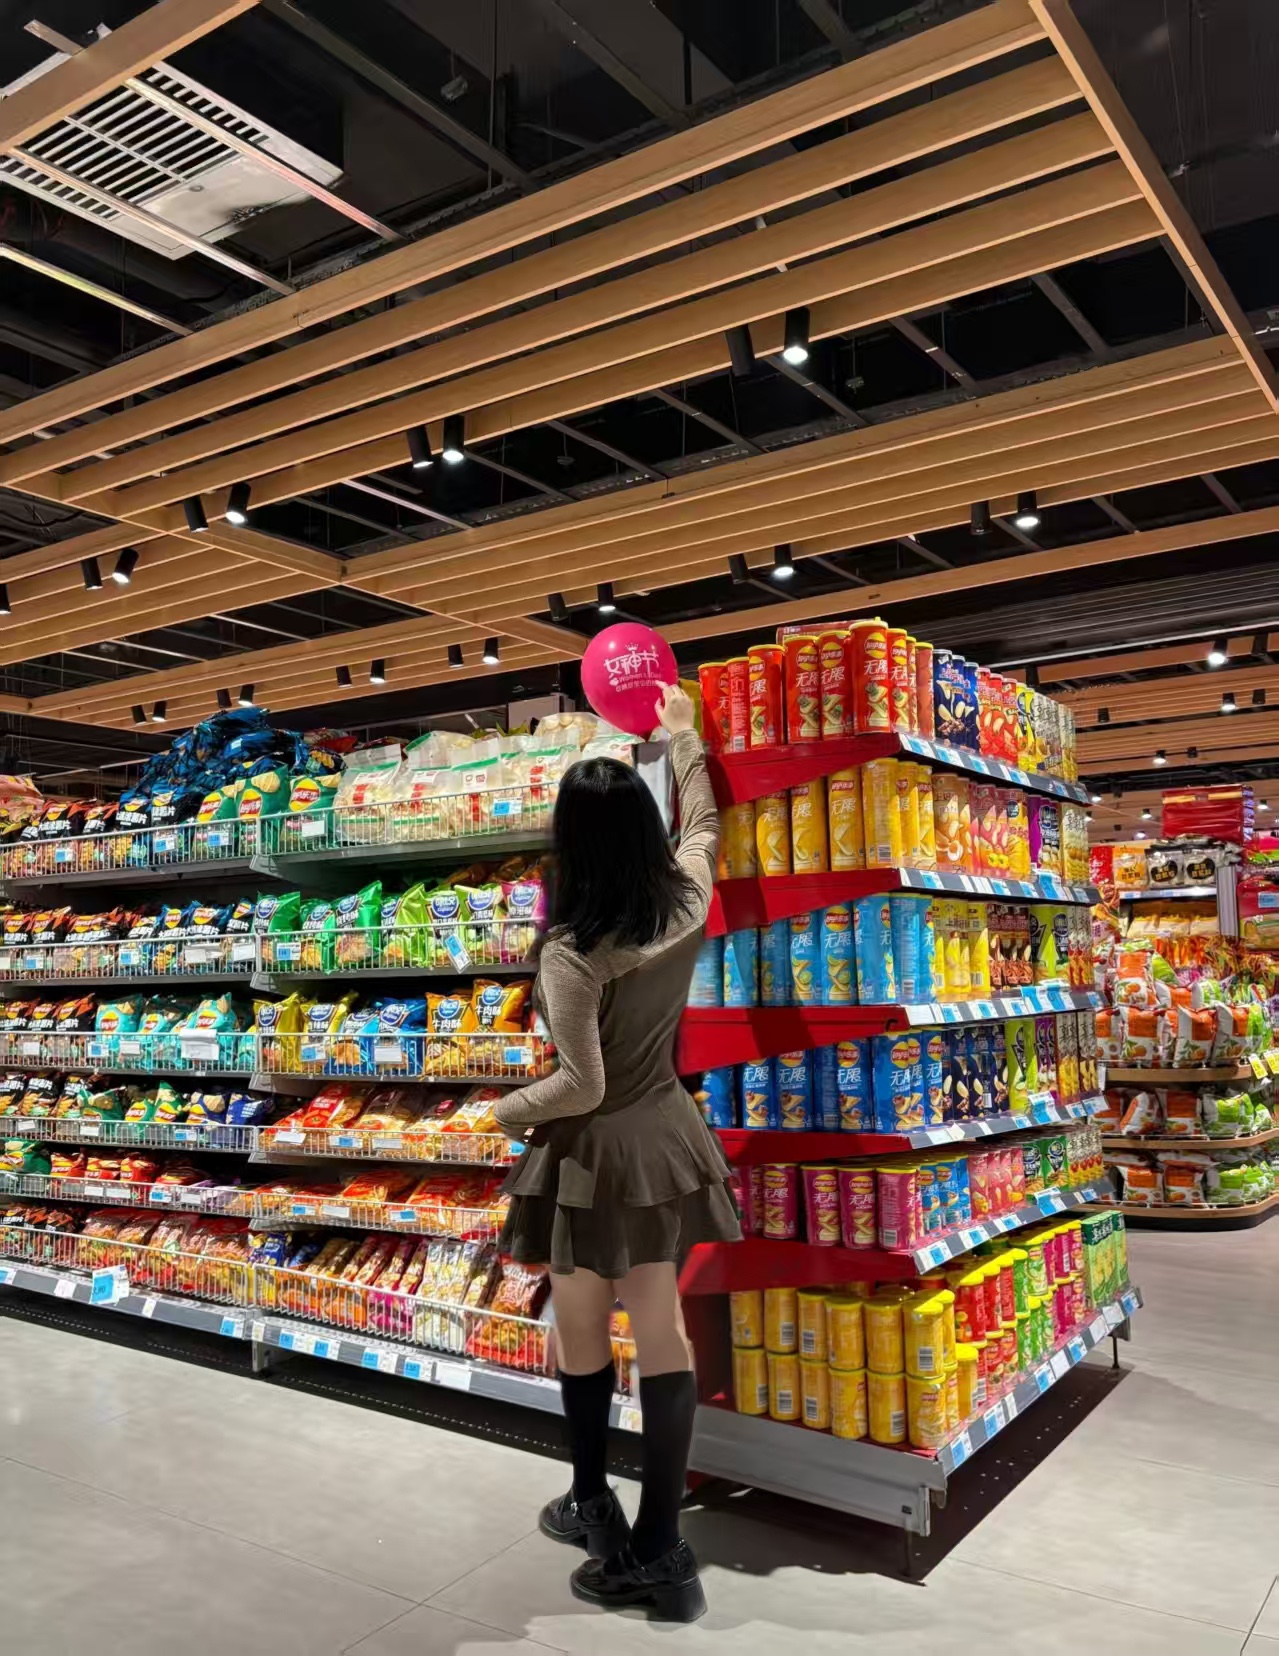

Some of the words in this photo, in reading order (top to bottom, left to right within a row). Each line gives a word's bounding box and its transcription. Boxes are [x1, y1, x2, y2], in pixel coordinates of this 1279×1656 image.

[603, 649, 660, 679] 女神节
[743, 1065, 769, 1083] 无限
[779, 1066, 806, 1084] 无限
